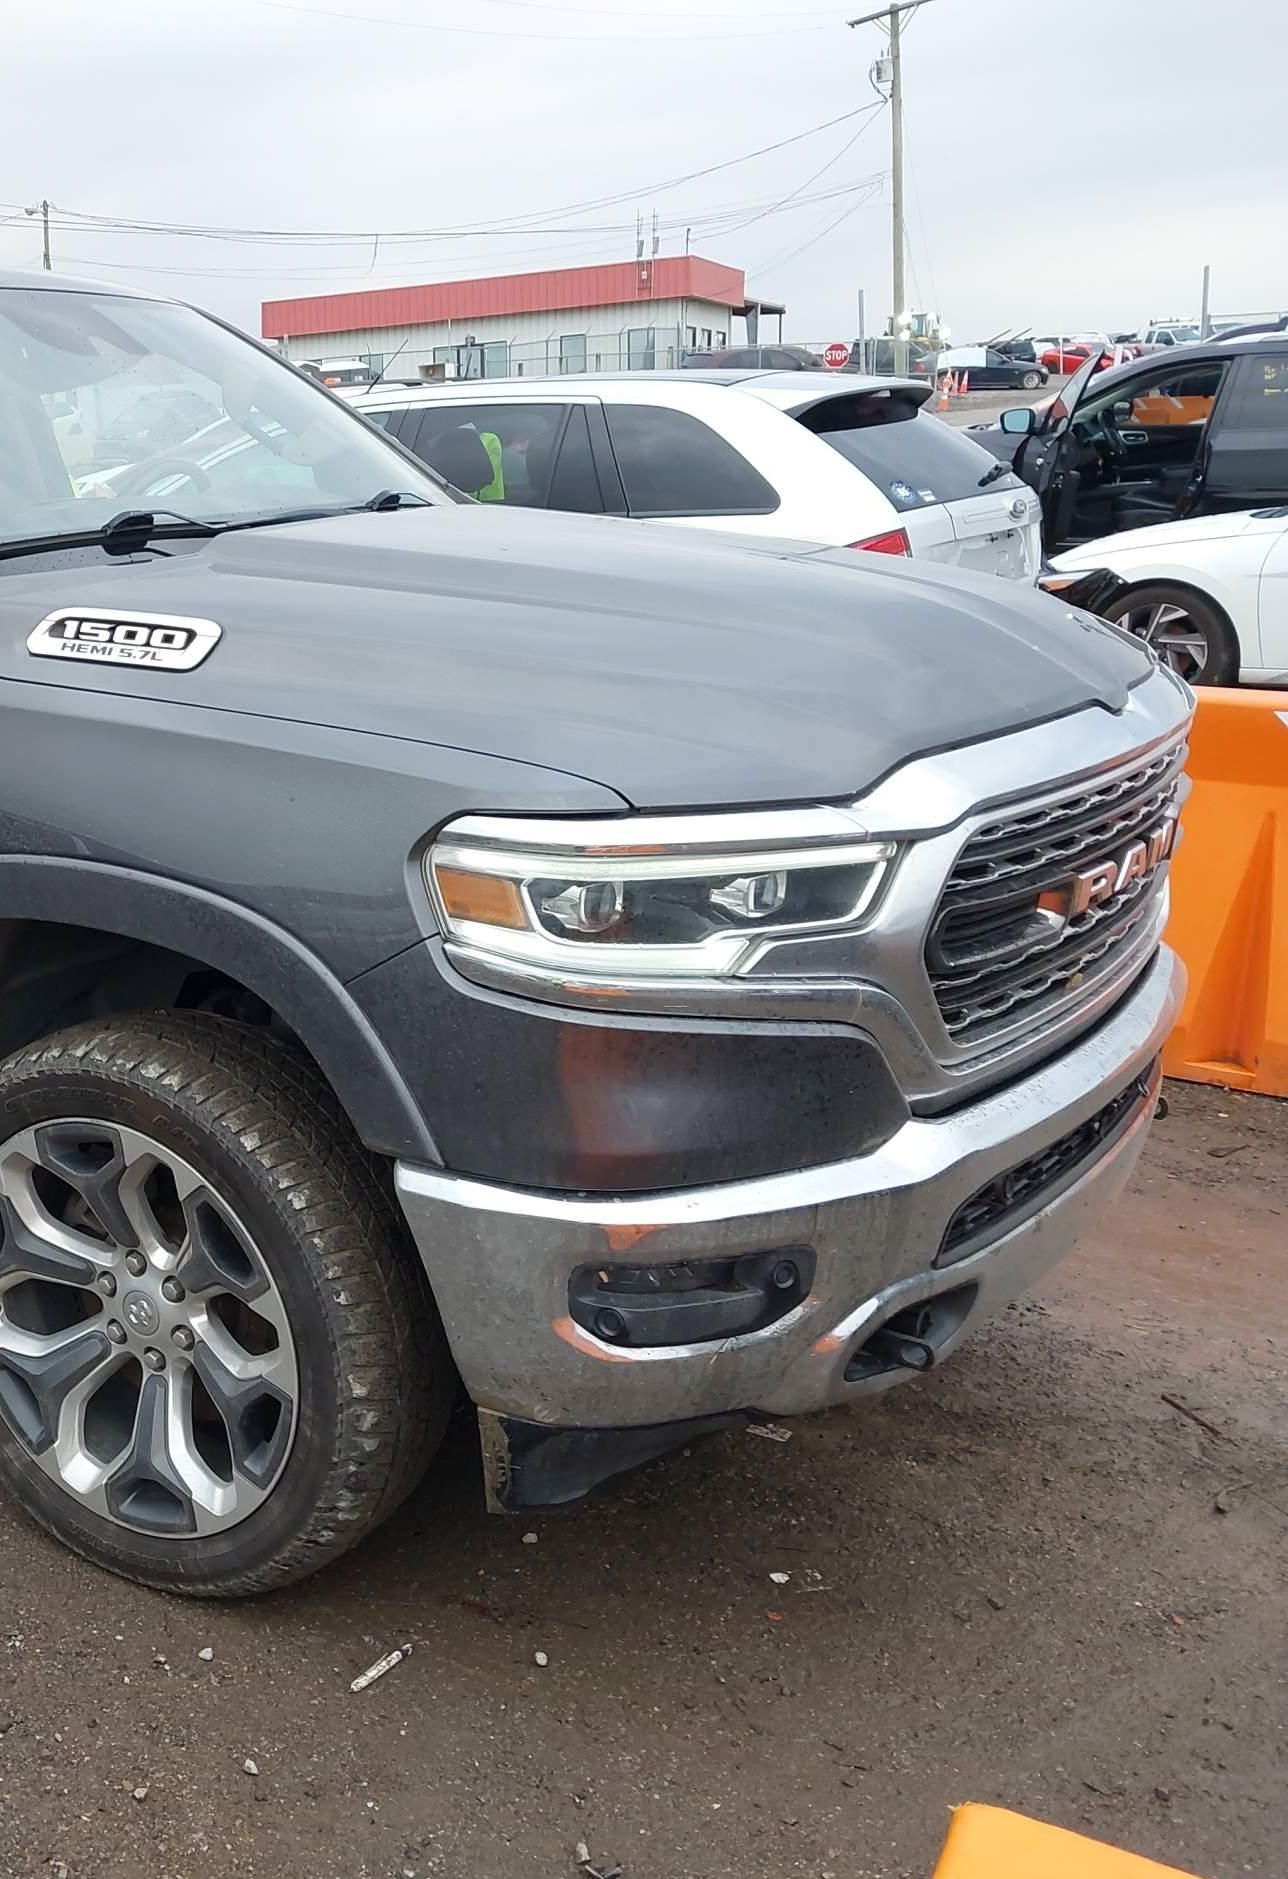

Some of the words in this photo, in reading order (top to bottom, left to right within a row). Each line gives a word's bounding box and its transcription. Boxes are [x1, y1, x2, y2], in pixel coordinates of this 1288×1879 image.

[825, 349, 847, 361] STOP
[62, 619, 190, 650] 1500
[61, 642, 114, 656] HEMI
[118, 647, 164, 662] 5.7L
[1075, 819, 1173, 913] RAM
